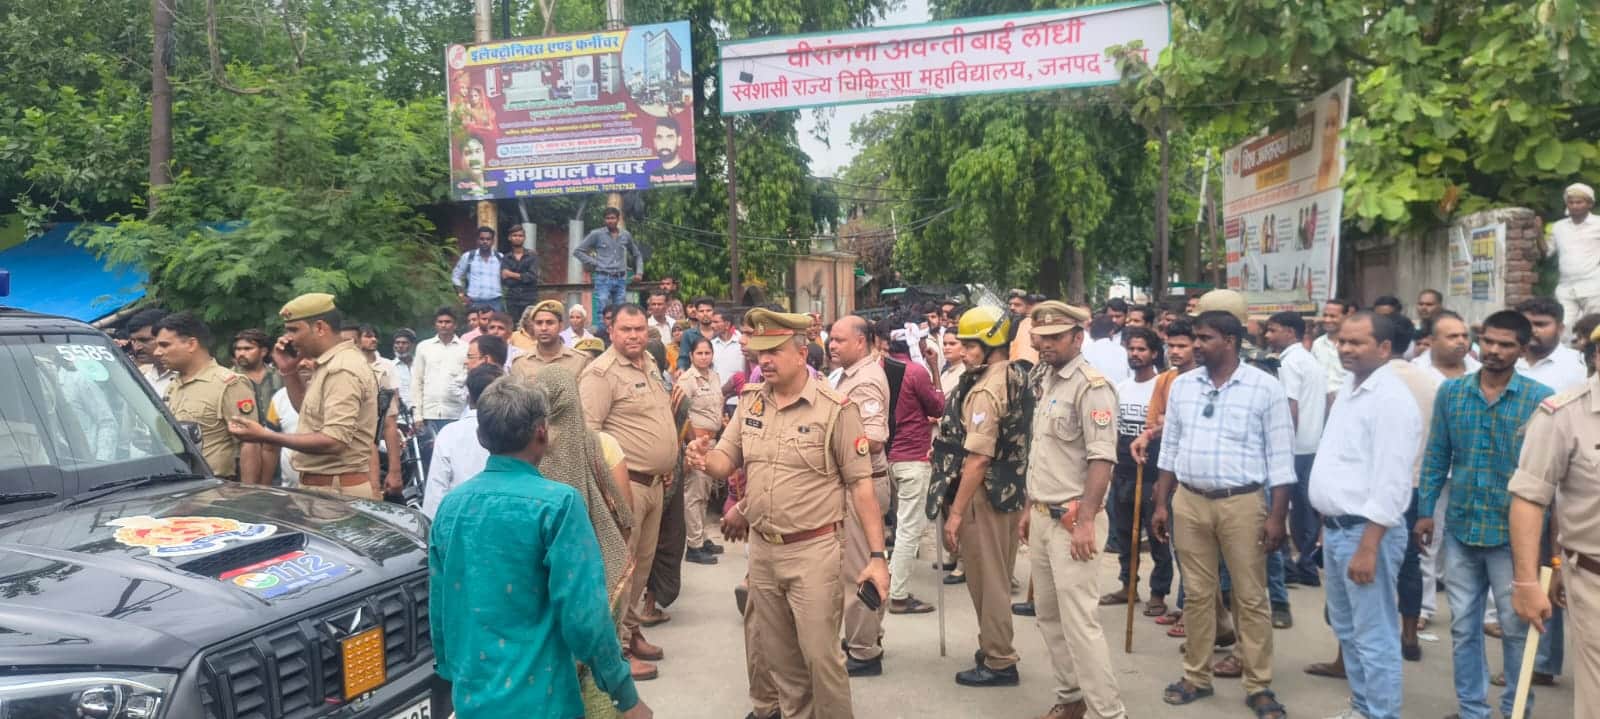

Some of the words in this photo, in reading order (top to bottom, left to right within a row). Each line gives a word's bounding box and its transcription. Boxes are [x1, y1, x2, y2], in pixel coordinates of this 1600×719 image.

[786, 39, 880, 67] वीरांगना
[884, 27, 965, 60] अवन्ती
[970, 22, 1016, 54] बाई
[792, 77, 832, 97] राज्य
[837, 68, 913, 93] चिकित्सा
[504, 164, 588, 183] अग्रवाल
[593, 159, 646, 177] टावर
[55, 344, 115, 362] 5585
[266, 554, 335, 582] 112
